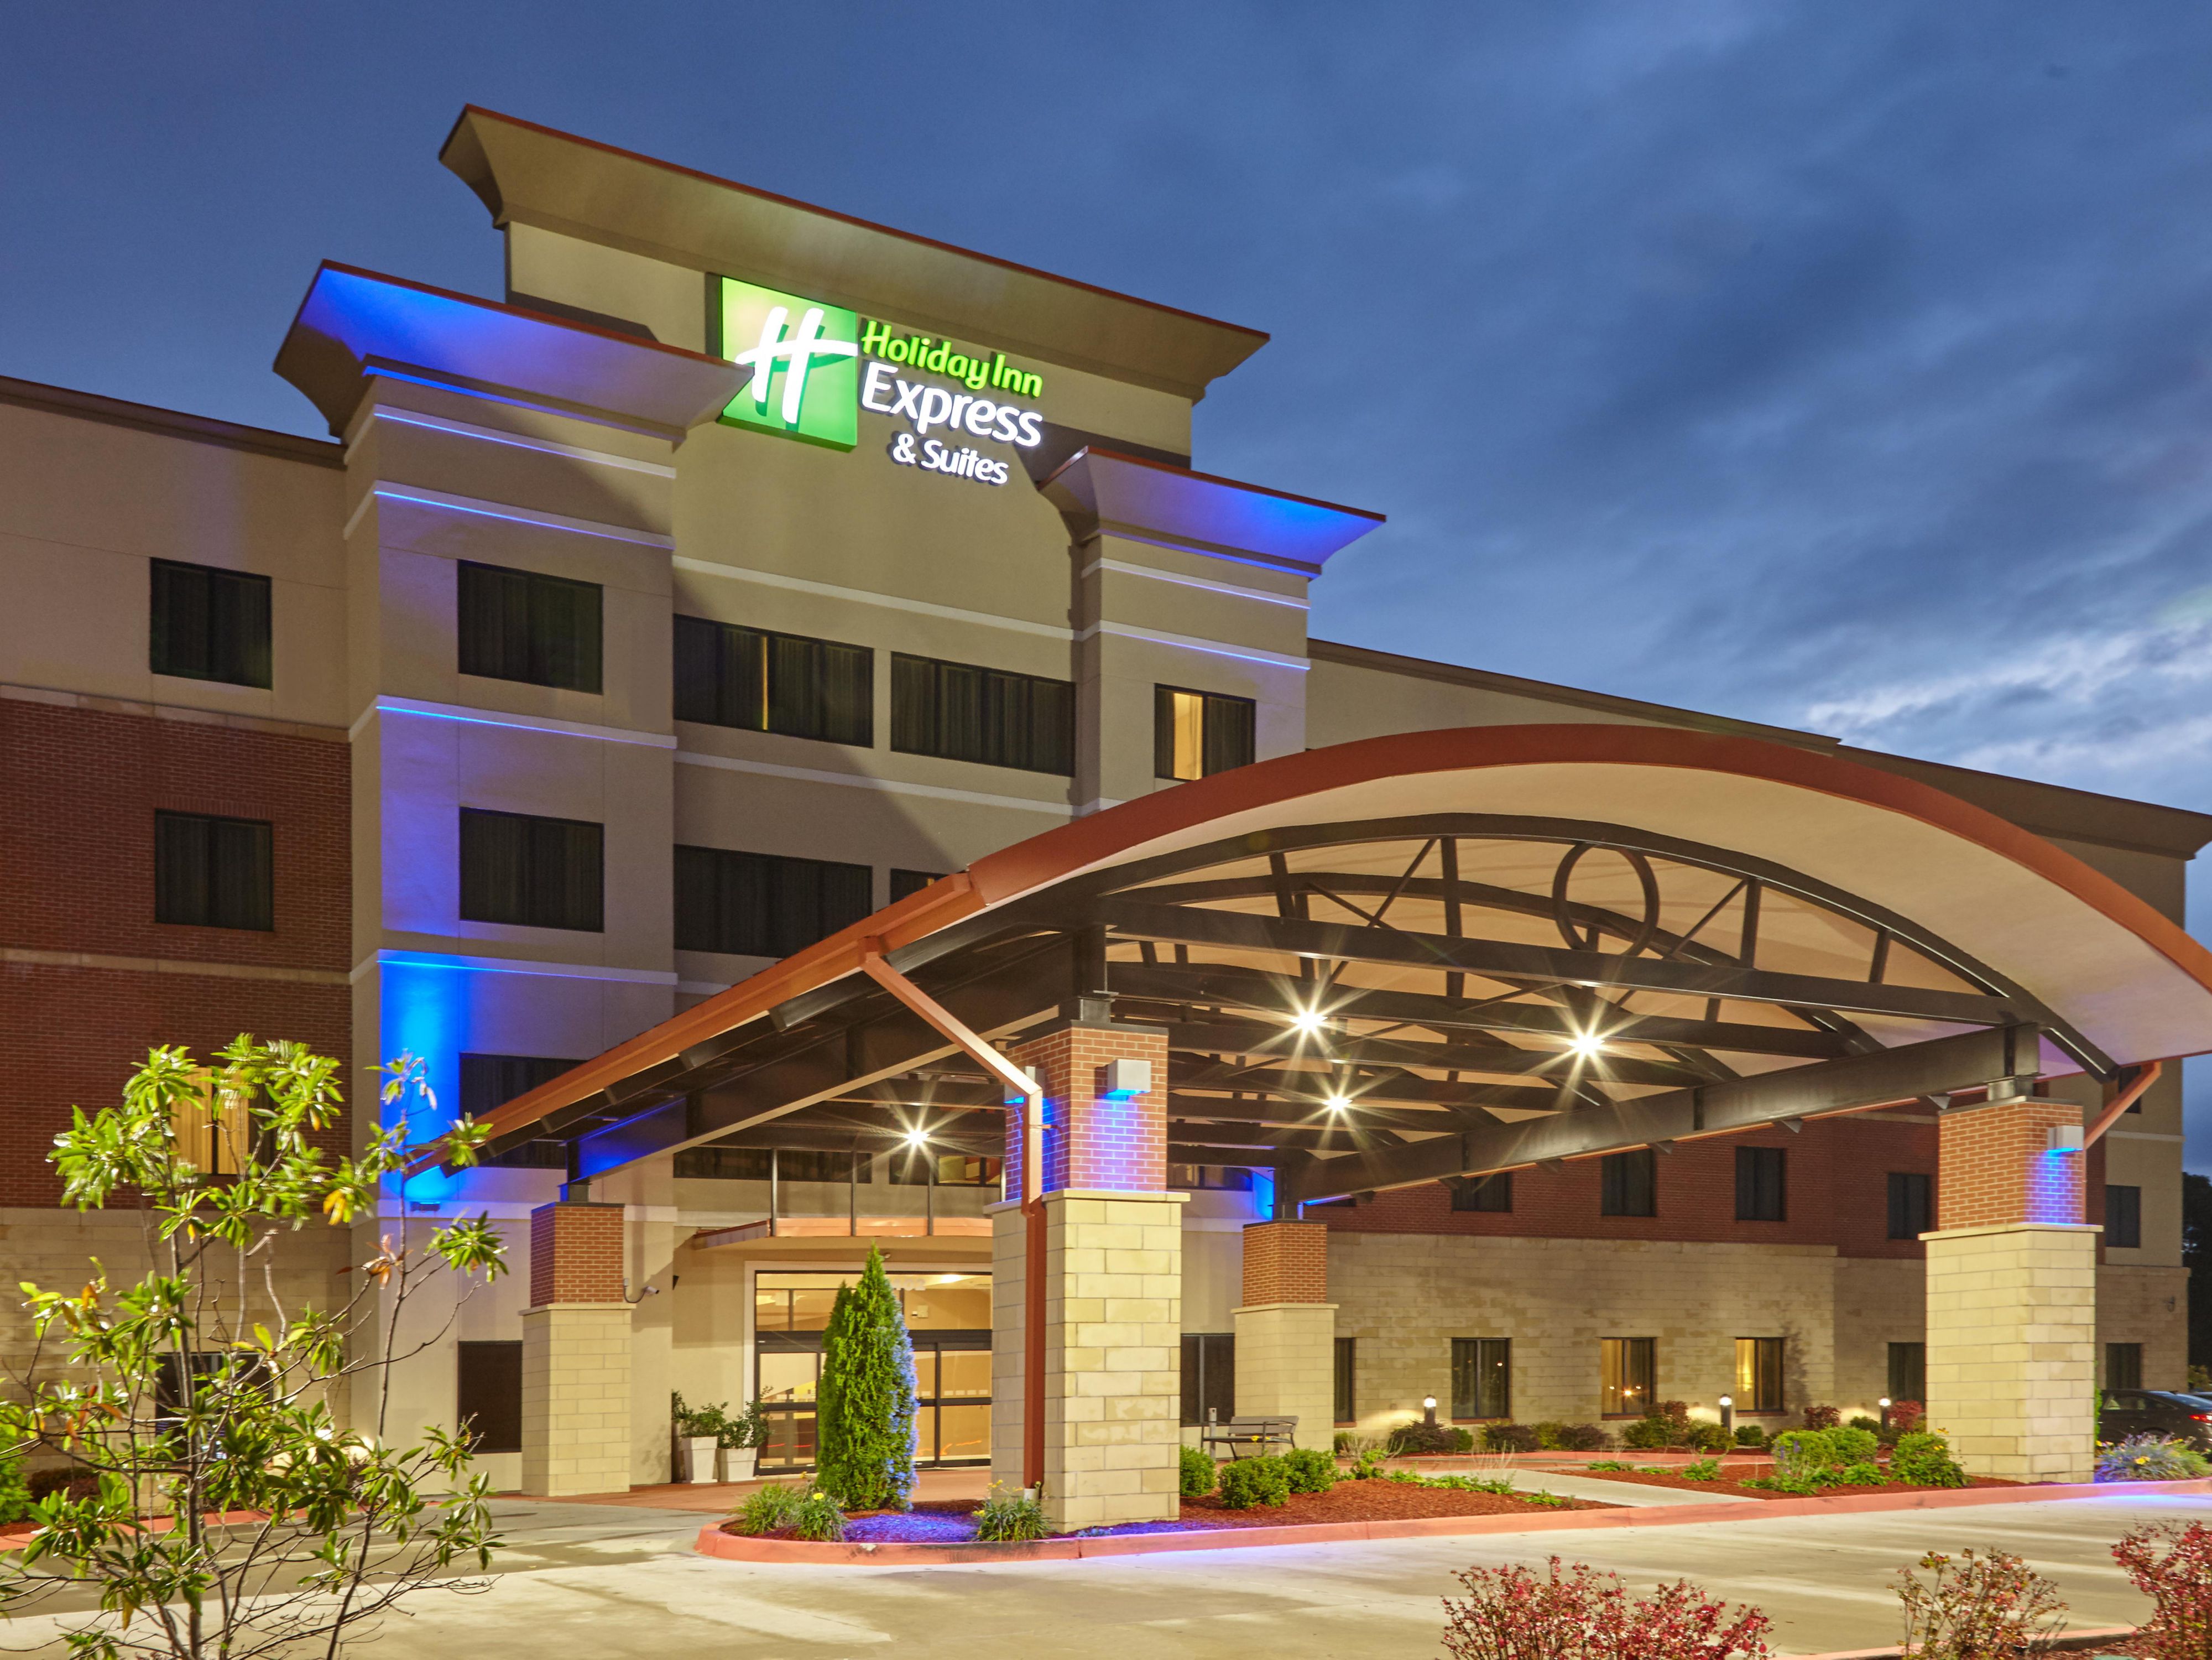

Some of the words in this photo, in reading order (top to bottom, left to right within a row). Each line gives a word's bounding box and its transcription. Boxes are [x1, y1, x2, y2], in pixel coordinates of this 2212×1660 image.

[861, 320, 990, 390] Holiday
[992, 353, 1043, 398] Inn
[862, 361, 1043, 447] Express
[893, 433, 916, 464] &
[921, 440, 1009, 484] Suites
